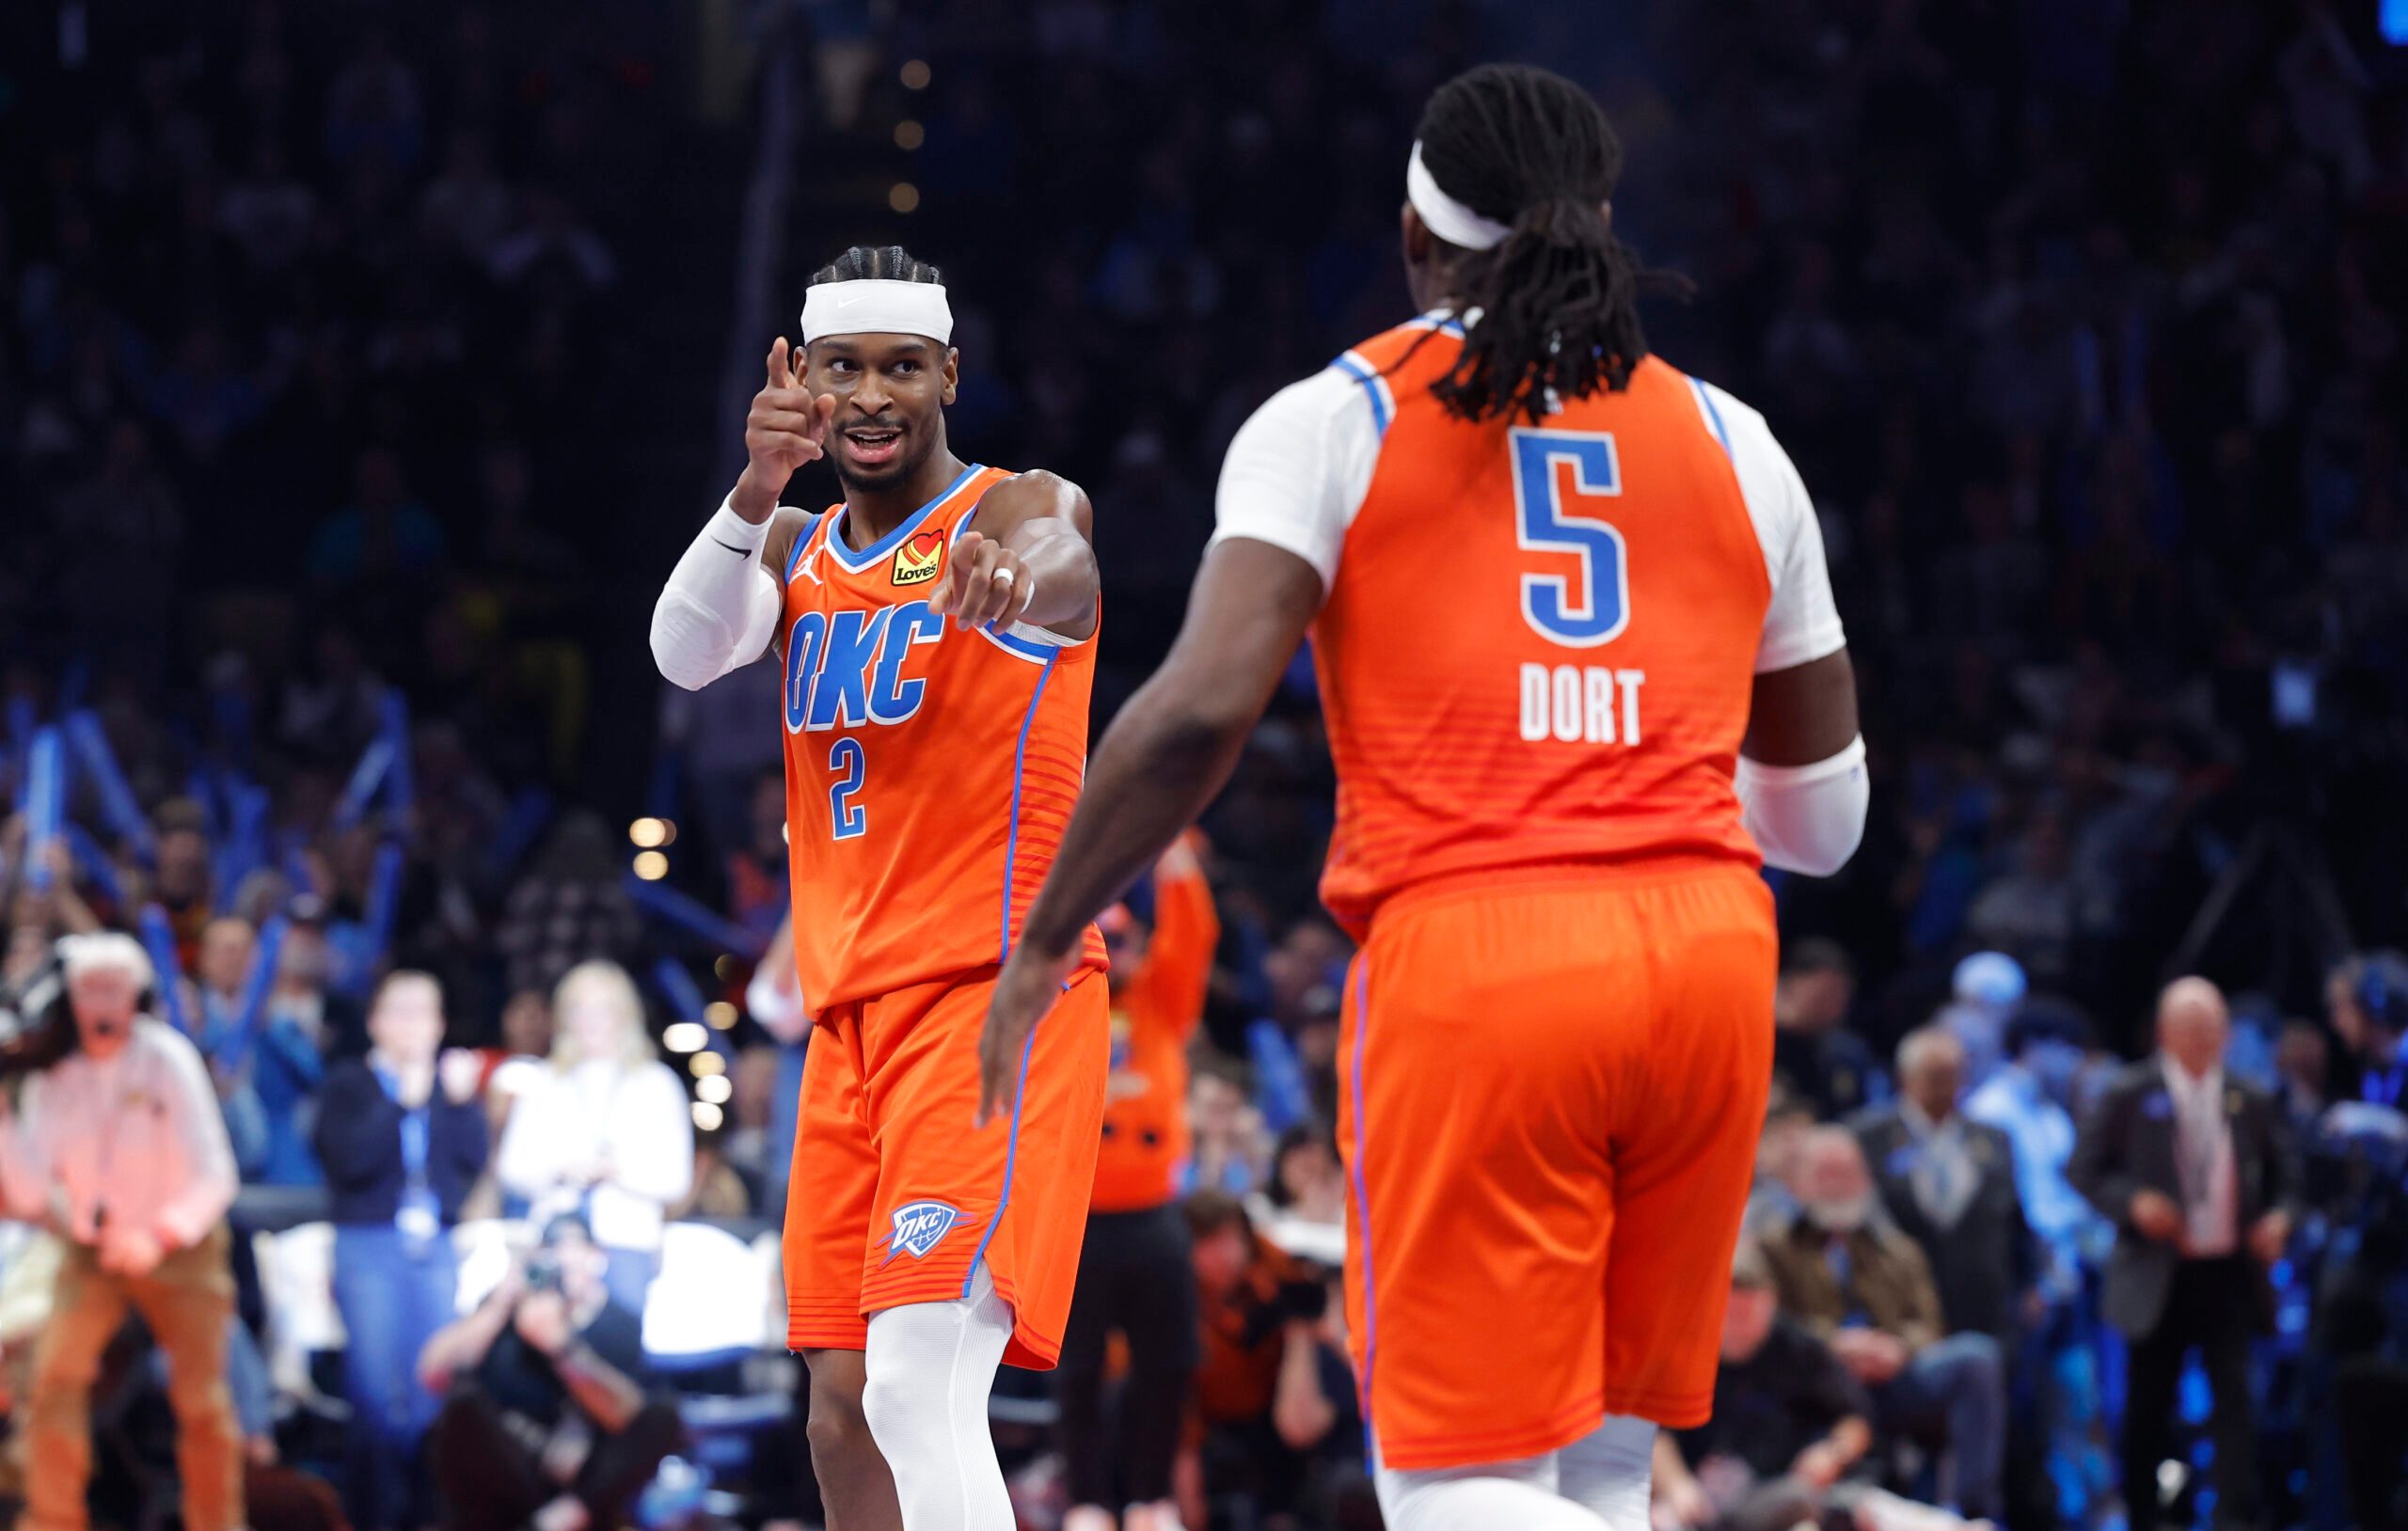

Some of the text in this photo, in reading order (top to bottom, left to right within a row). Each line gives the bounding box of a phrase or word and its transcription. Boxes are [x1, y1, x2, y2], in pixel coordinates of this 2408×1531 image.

[1507, 426, 1630, 648] 5
[785, 600, 945, 734] OKC
[1519, 662, 1645, 747] DORT
[830, 736, 866, 841] 2
[891, 1210, 942, 1250] OKC
